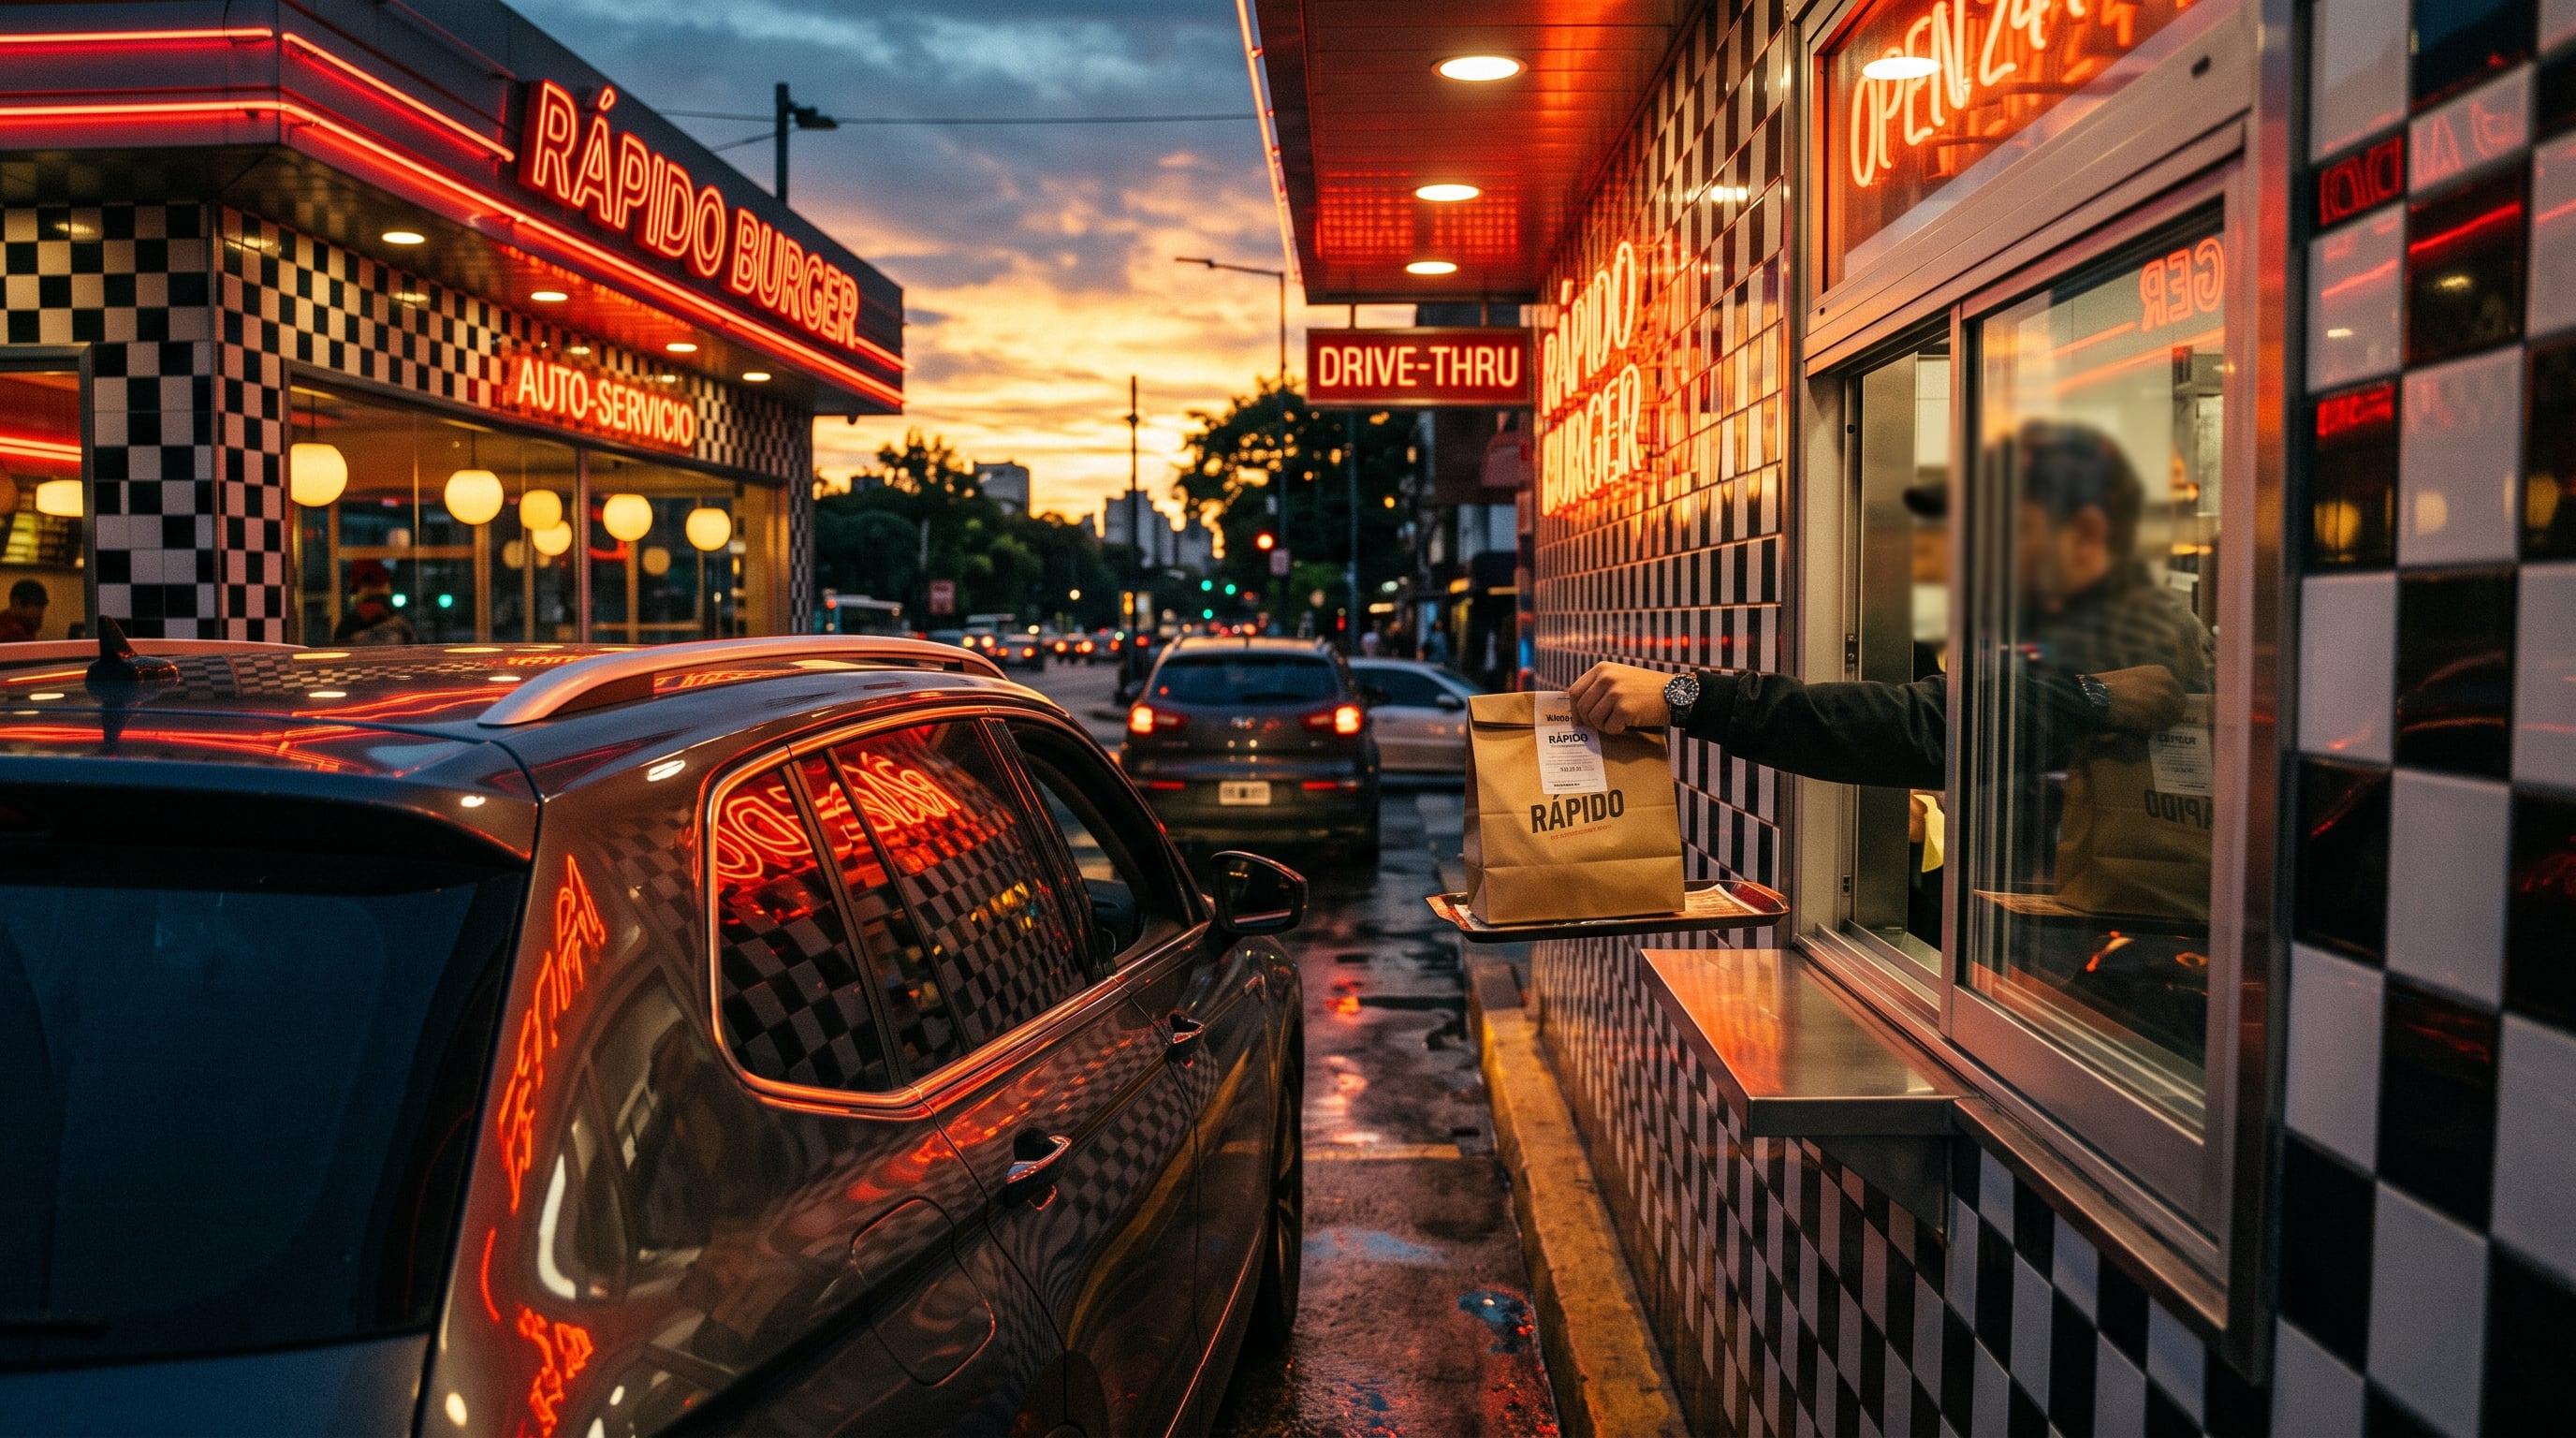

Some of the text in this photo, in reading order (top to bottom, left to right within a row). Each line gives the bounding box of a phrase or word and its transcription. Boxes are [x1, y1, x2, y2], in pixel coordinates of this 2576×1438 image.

[1850, 0, 1966, 187] OPEN
[533, 80, 860, 349] RÁPIDO BURGER
[517, 357, 695, 448] AUTO-SERVICIO
[1318, 345, 1519, 388] DRIVE-THRU
[1542, 241, 1637, 418] RÁPIDO
[1542, 362, 1642, 517] BURGER
[1530, 788, 1624, 834] RÁPIDO
